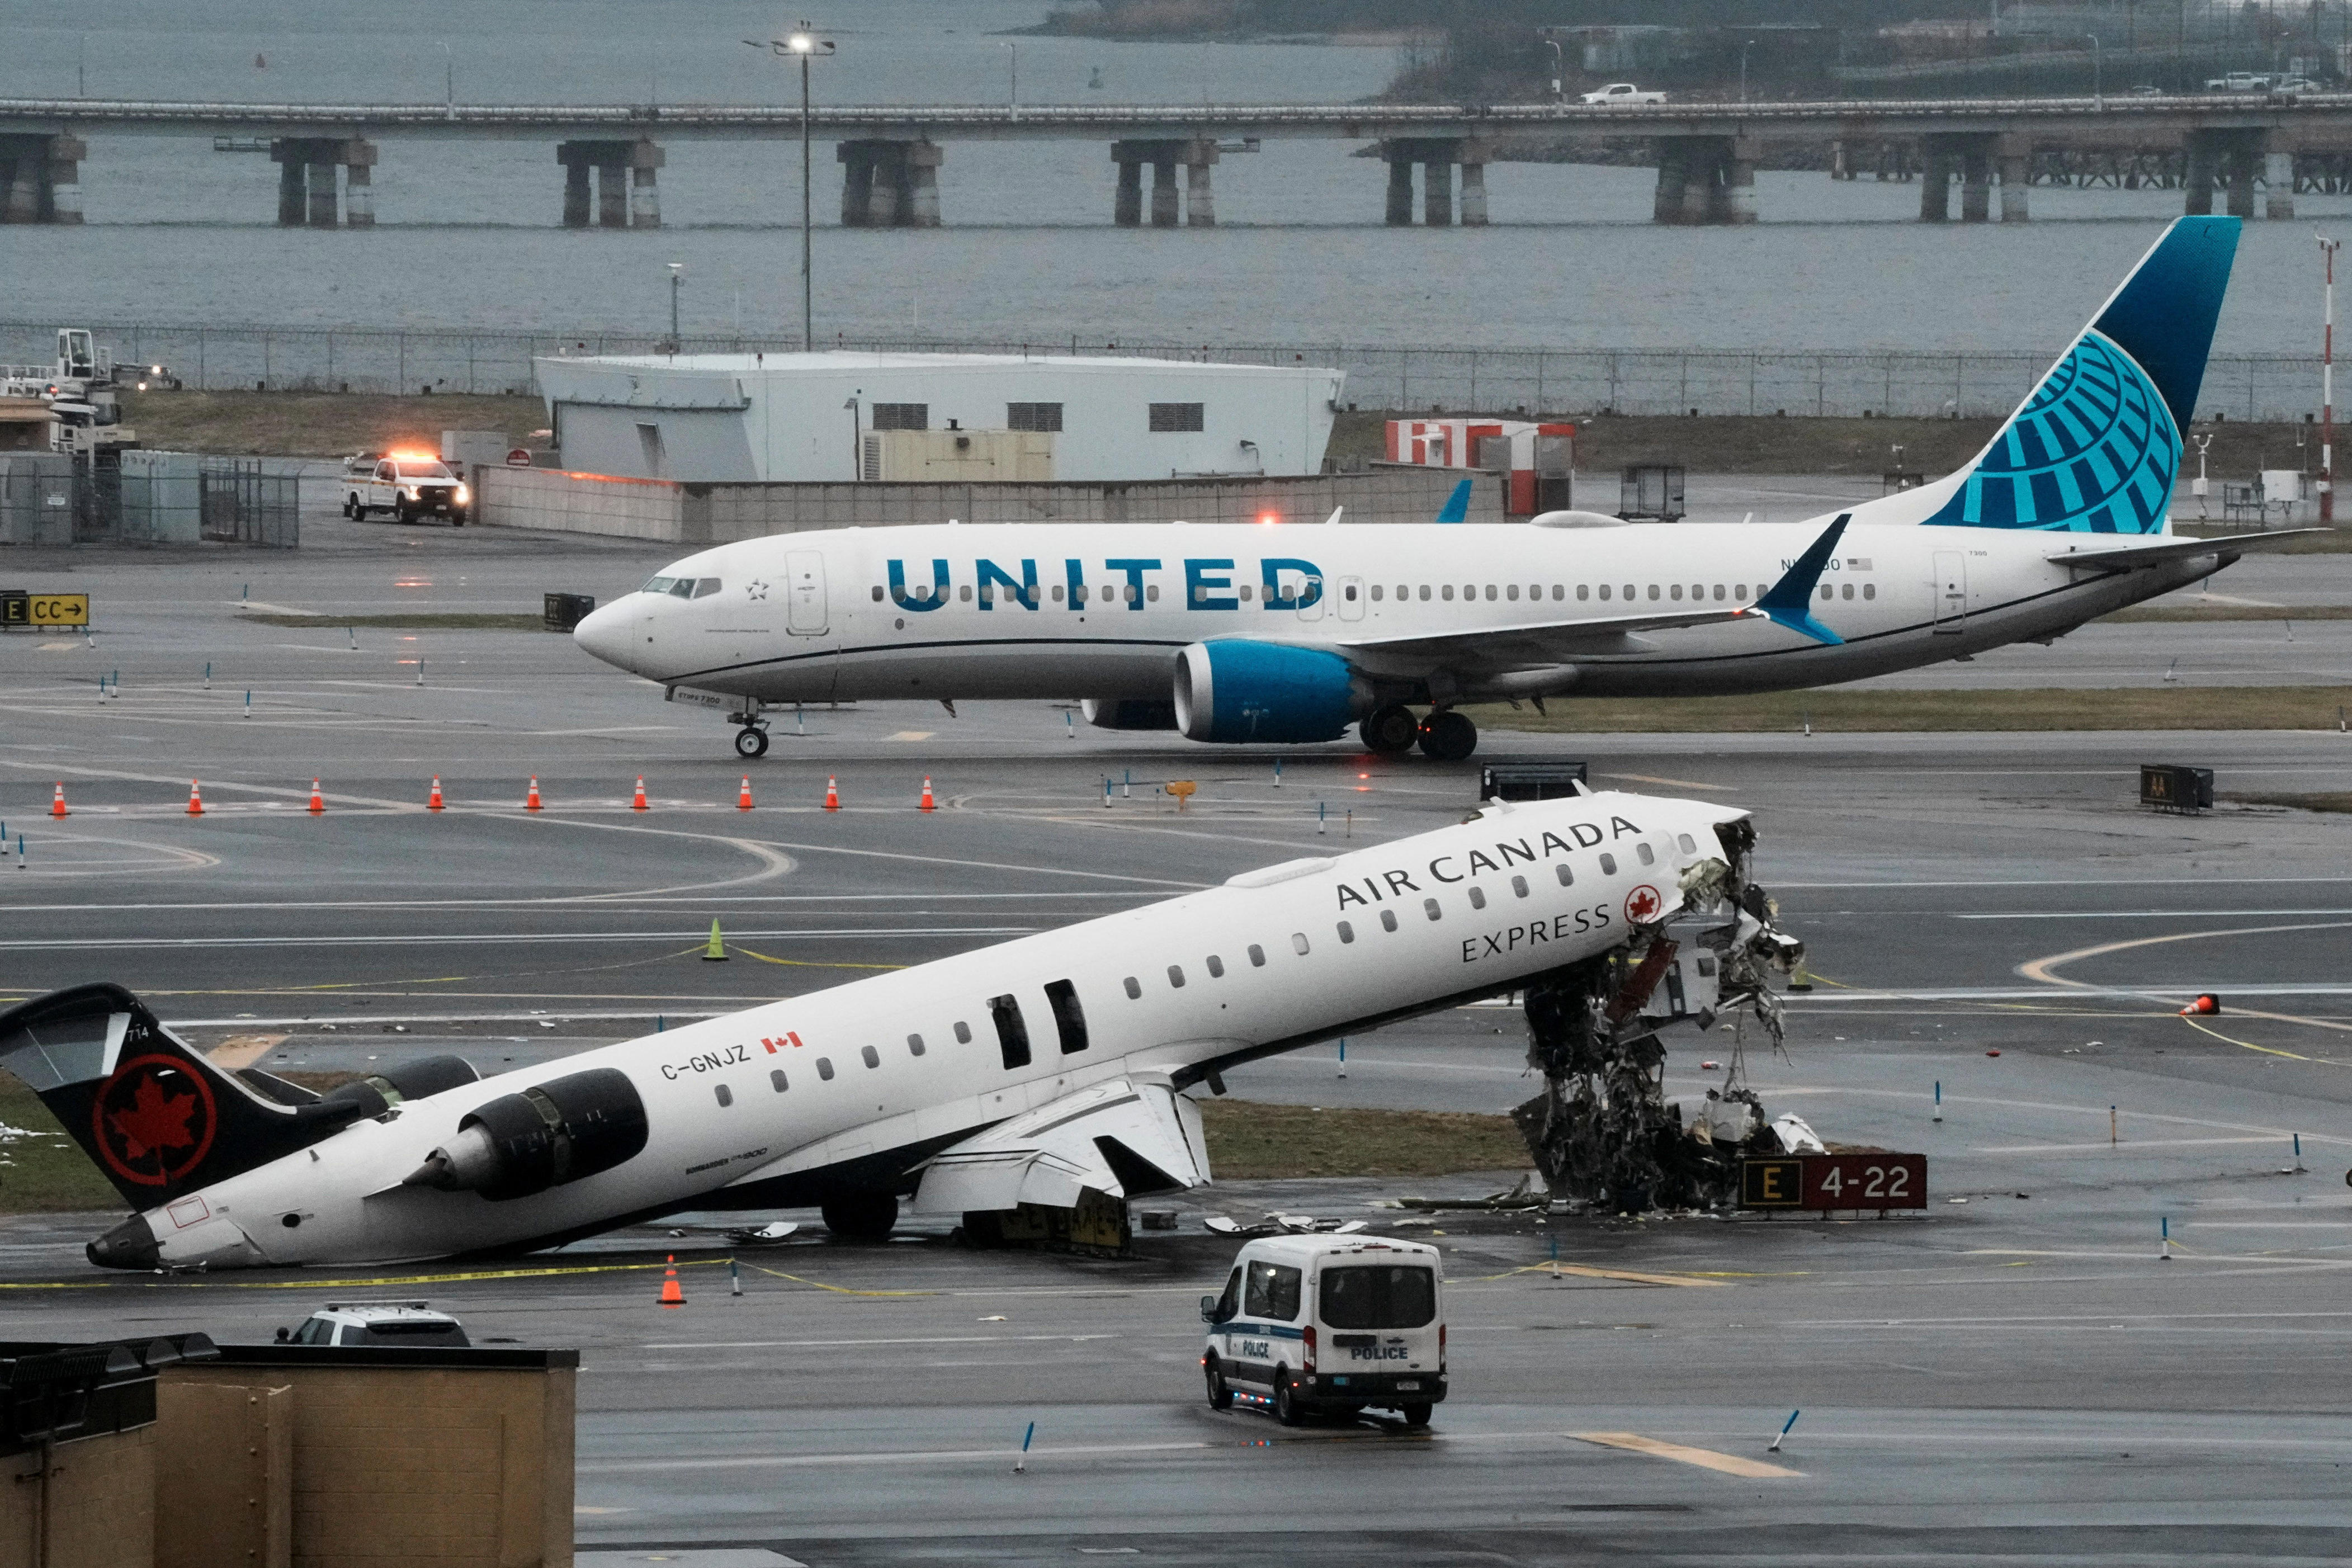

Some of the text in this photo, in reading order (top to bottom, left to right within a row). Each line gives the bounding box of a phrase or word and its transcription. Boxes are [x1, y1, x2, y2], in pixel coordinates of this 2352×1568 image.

[886, 559, 1324, 612] UNITED
[8, 601, 61, 619] E CC
[1336, 815, 1643, 910] AIR CANADA
[1462, 904, 1610, 963] EXPRESS
[661, 1045, 752, 1080] C-GNJZ
[1764, 1166, 1909, 1198] E 4-22
[1243, 1339, 1269, 1359] POLICE
[1350, 1347, 1408, 1360] POLICE
